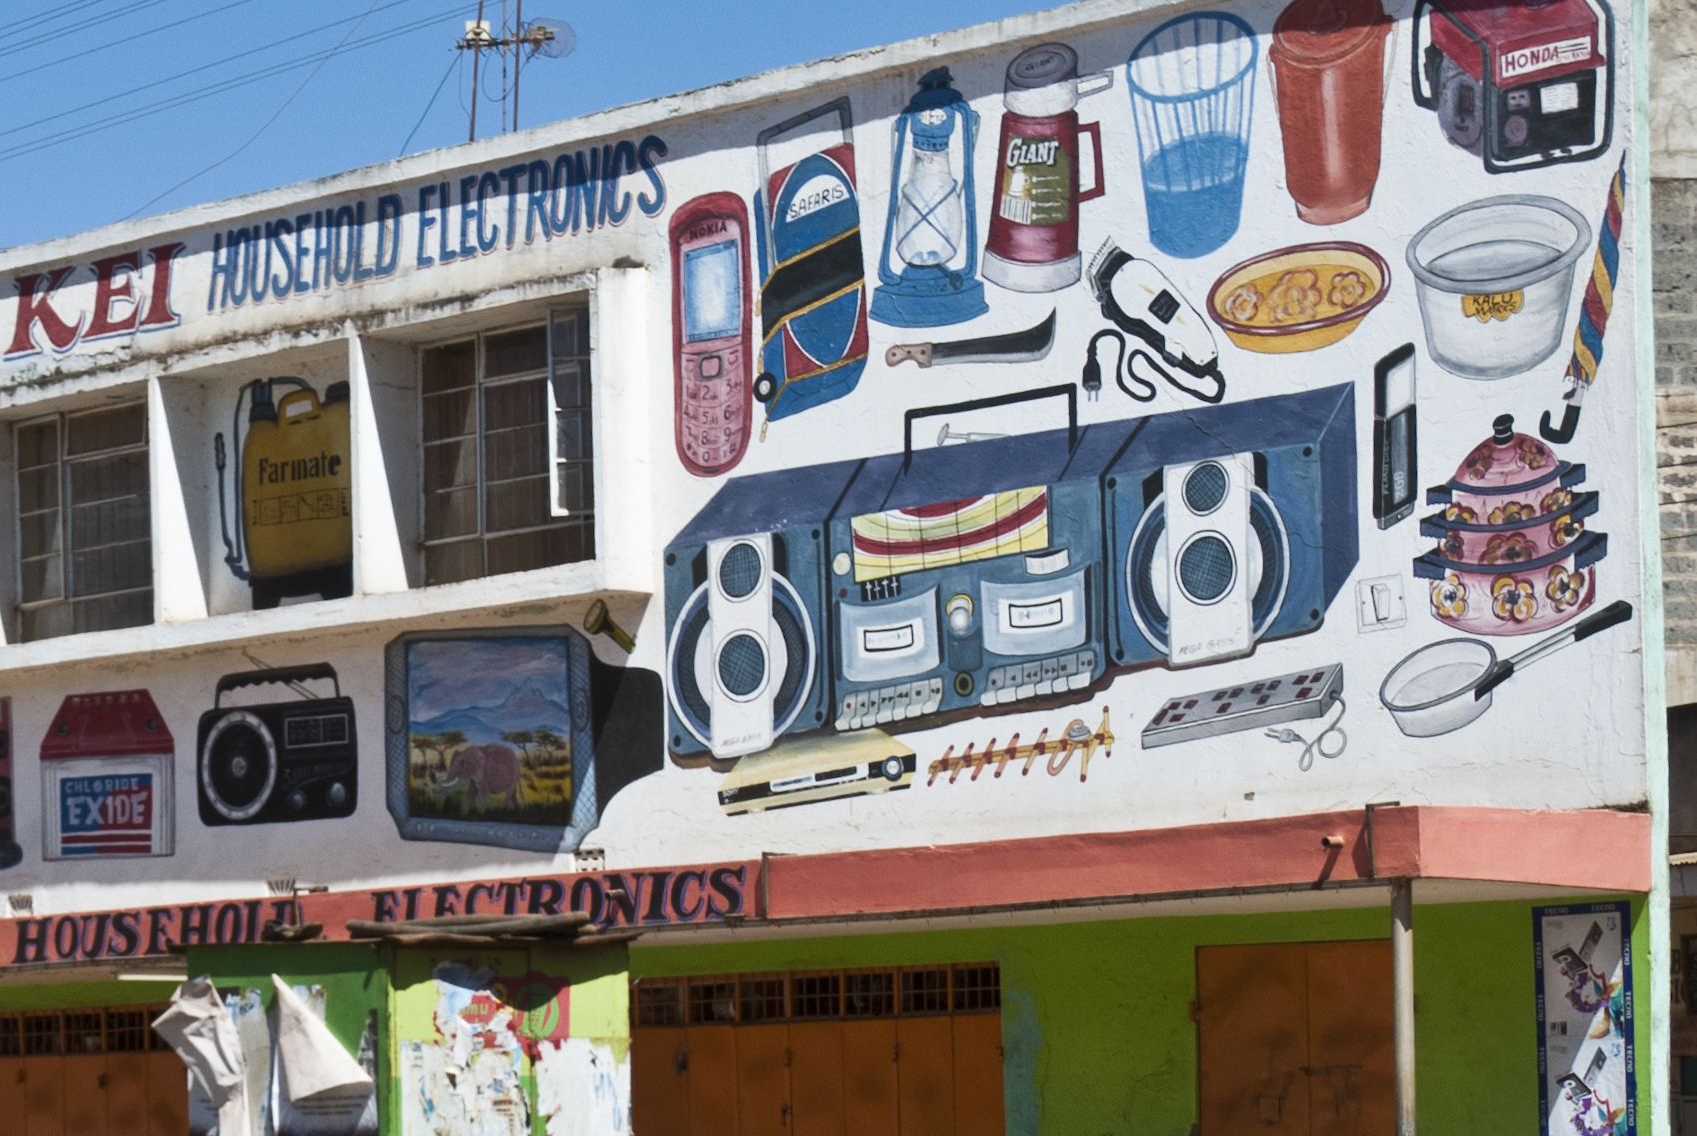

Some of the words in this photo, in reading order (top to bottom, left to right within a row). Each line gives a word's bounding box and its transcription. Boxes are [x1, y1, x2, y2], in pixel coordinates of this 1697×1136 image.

[1025, 56, 1054, 71] GIANT
[1505, 46, 1560, 73] HONDA
[1007, 137, 1059, 167] GIANT
[789, 184, 846, 220] SAFARIS
[207, 193, 403, 312] HOUSEHOLD
[415, 134, 670, 268] ELECTRONICS
[689, 221, 728, 240] NOKIA
[259, 450, 342, 486] Farmate
[65, 777, 140, 794] CHLORIDE
[66, 791, 148, 826] EXIDE
